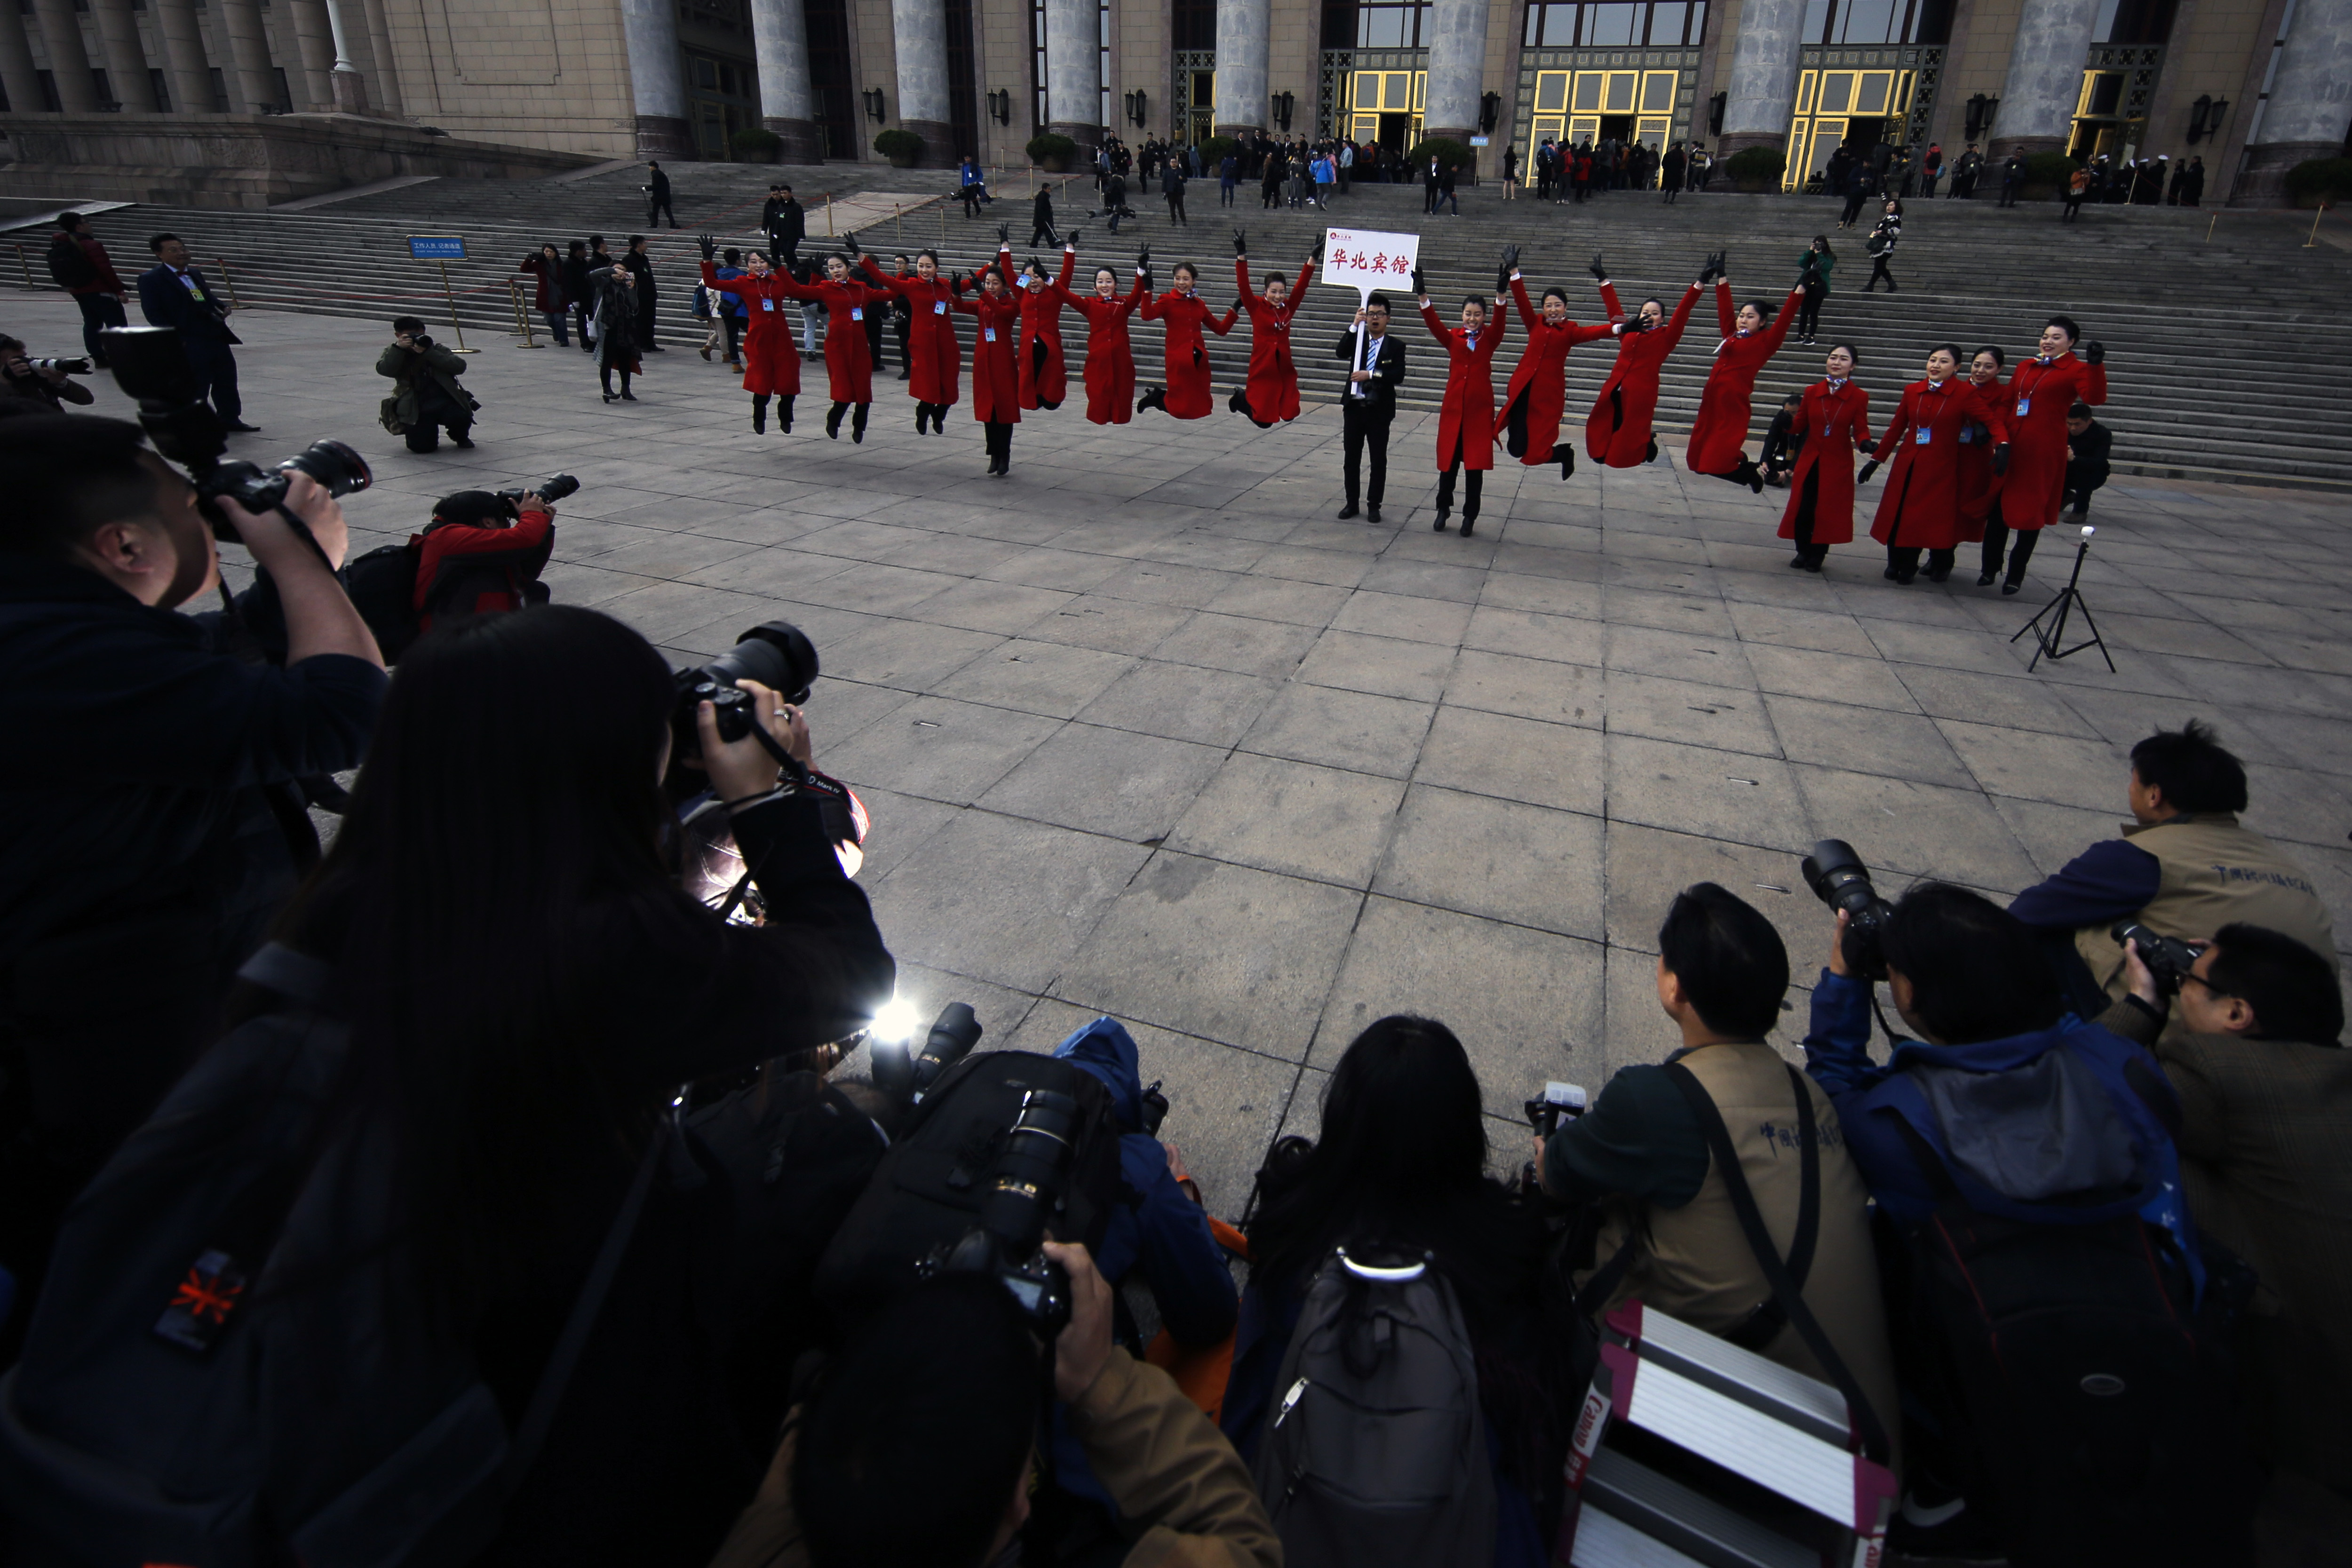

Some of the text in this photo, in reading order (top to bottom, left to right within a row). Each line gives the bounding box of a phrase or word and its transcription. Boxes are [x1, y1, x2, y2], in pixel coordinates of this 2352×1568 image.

[1330, 248, 1409, 274] 华北宾馆
[817, 781, 833, 791] Mark
[1574, 1395, 1603, 1448] Canon
